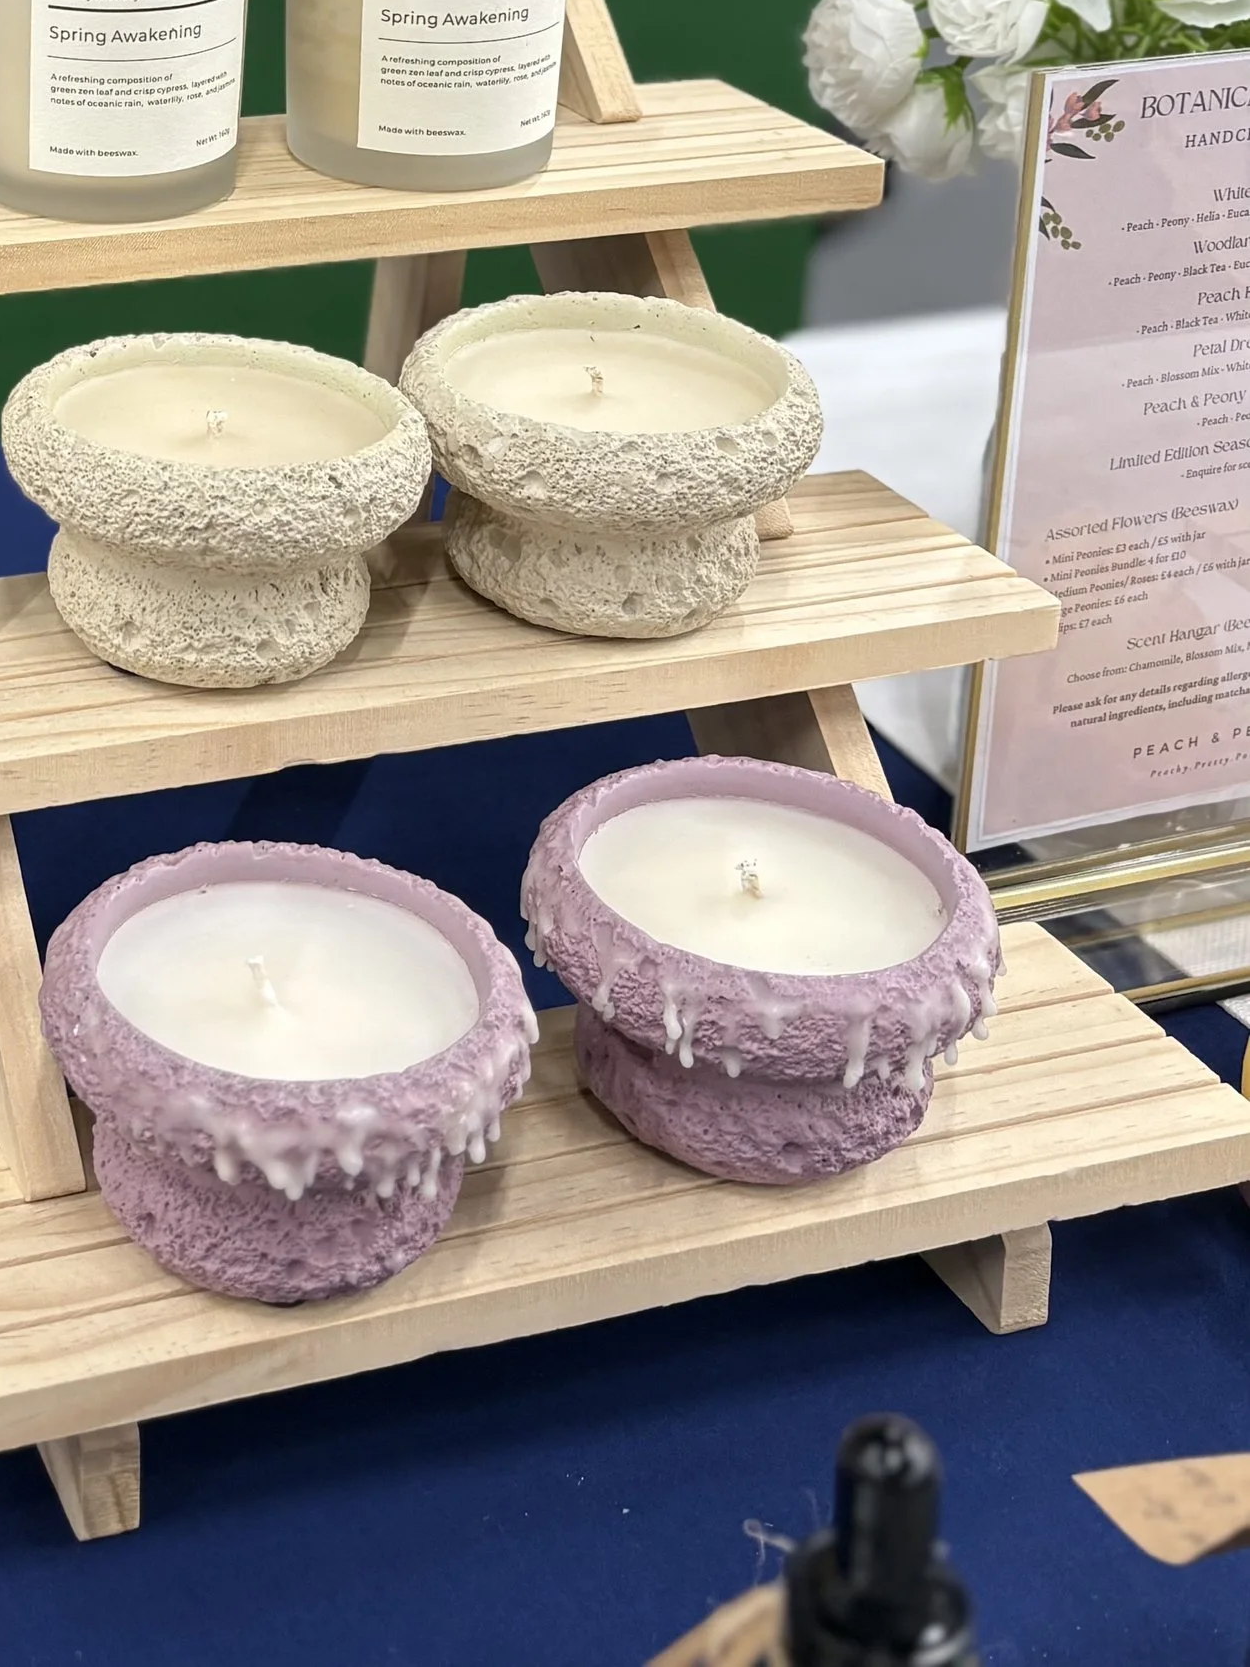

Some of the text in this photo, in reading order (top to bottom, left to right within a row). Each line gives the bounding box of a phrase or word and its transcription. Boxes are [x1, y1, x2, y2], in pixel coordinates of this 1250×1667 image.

[381, 9, 528, 29] Spring Awakening
[49, 24, 202, 46] Spring Awakening
[390, 56, 491, 67] refreshing composition
[58, 74, 163, 86] refreshing composition
[381, 67, 407, 76] green
[427, 69, 443, 77] leaf
[445, 69, 461, 77] and
[463, 69, 484, 77] crisp
[50, 87, 77, 96] green
[97, 88, 113, 96] leaf
[115, 88, 132, 96] and
[134, 88, 155, 96] crisp
[380, 78, 405, 86] notes
[50, 98, 75, 106] notes
[1140, 86, 1250, 119] BOTANIC
[379, 125, 402, 134] Made
[50, 146, 74, 155] Made
[1126, 217, 1190, 232] Peach Peony
[1113, 263, 1226, 286] Peach Peony Black Tea
[1198, 288, 1240, 305] Peach
[1142, 316, 1218, 334] Peach Black Tea
[1194, 340, 1226, 357] Petal
[1127, 366, 1220, 388] Peach Blossom Mix
[1144, 390, 1246, 415] Peach & Peony
[1202, 414, 1228, 426] Peach
[1110, 445, 1209, 470] Limited Edition
[1186, 462, 1236, 478] Enquire for
[1045, 499, 1239, 542] Assorted Flowers (Beeswax)
[1052, 531, 1206, 564] Mini Peonies: £3 each £5 with jar
[1050, 550, 1186, 582] Mini Peonies for £10
[1161, 558, 1236, 580] £4 each £6 with
[1114, 592, 1148, 605] £6 each
[1079, 619, 1089, 629] £7
[1091, 615, 1112, 626] each
[1127, 625, 1220, 649] Scent Hangar
[1067, 648, 1222, 684] Choose Chamomile, Blossom
[1052, 676, 1219, 714] Please ask for any details regarding
[1071, 694, 1213, 728] natural ingredients, including
[1133, 732, 1220, 759] PEACH &
